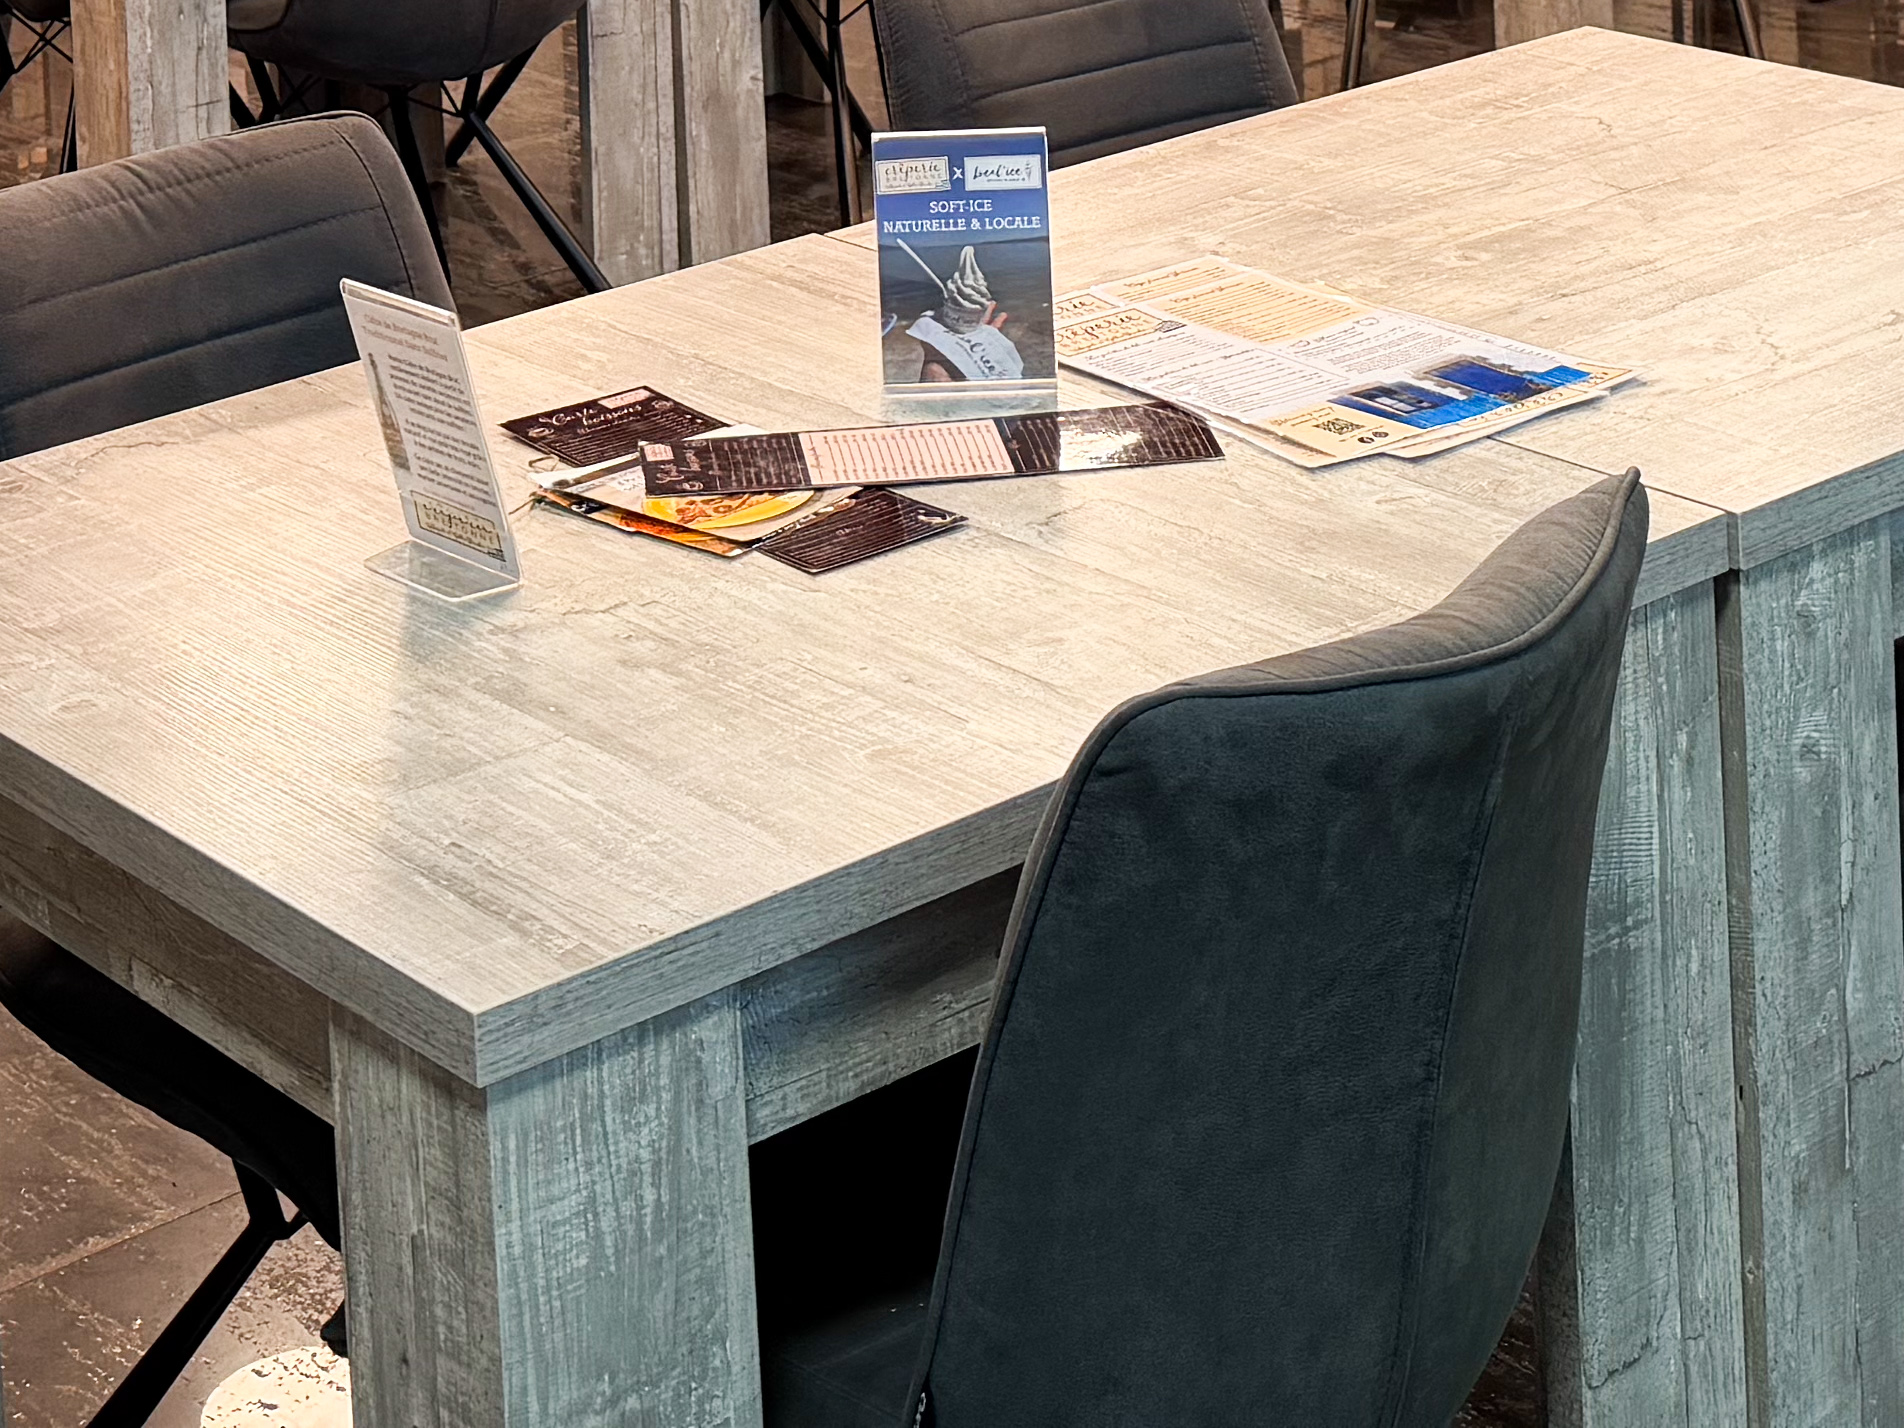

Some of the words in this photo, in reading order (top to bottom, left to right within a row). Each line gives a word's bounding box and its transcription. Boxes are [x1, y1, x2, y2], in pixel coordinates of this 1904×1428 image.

[929, 199, 993, 214] SOFT-ICE
[883, 218, 966, 233] NATURELLE
[970, 218, 981, 230] &
[985, 215, 1042, 230] LOCALE
